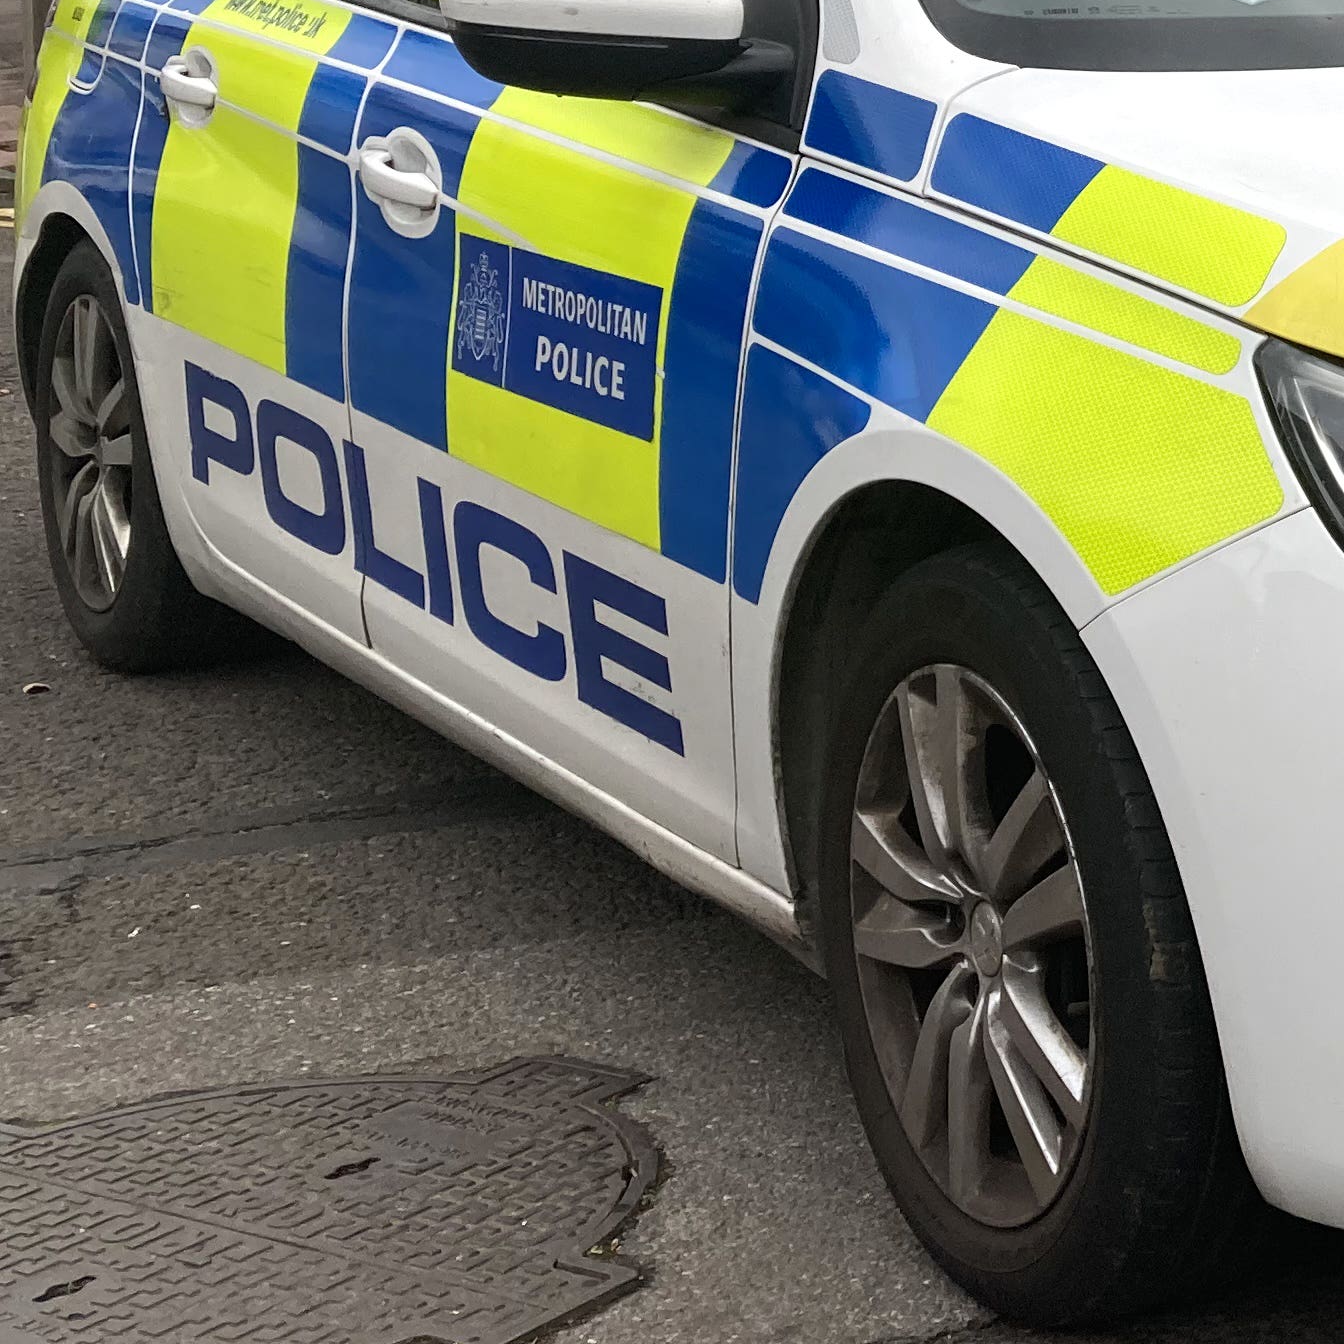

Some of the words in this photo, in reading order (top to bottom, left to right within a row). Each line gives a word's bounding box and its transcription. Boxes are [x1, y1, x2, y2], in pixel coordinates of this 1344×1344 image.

[522, 277, 648, 346] METROPOLITAN
[535, 335, 625, 401] POLICE
[184, 359, 685, 757] POLICE
